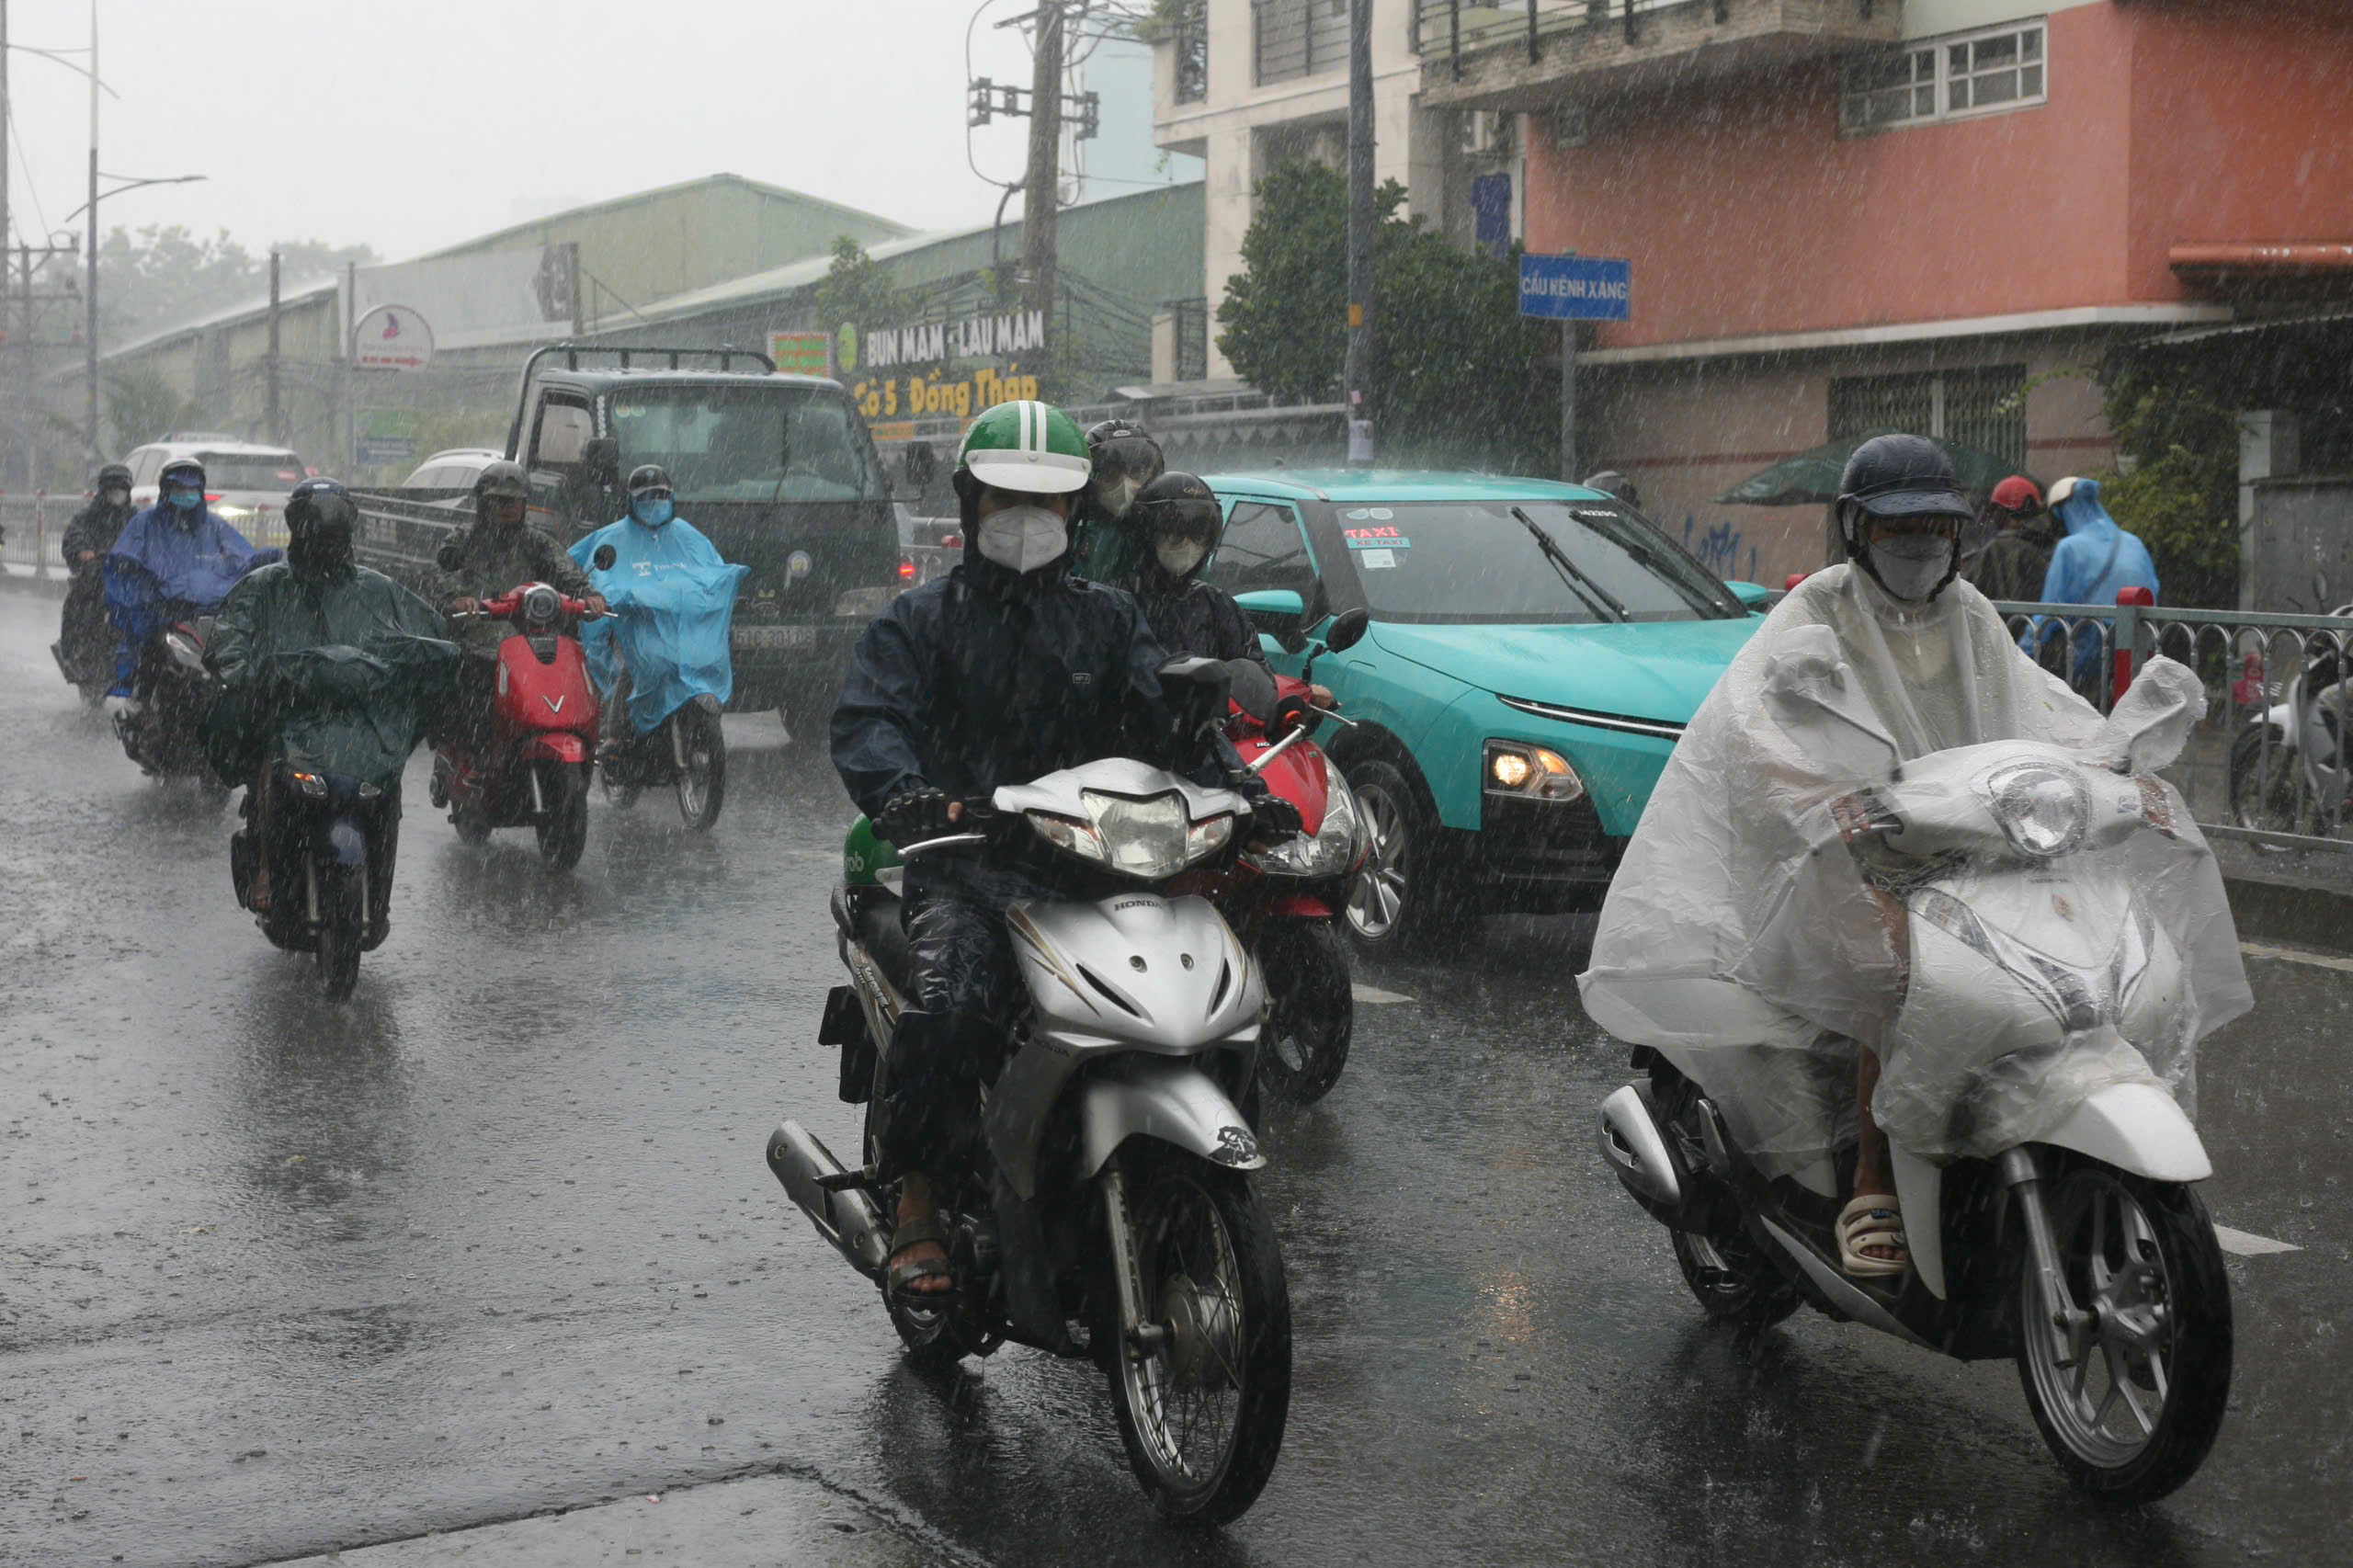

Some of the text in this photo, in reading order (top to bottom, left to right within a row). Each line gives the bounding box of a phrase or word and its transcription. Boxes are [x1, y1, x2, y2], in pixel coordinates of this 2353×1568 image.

[885, 379, 898, 416] 5
[1345, 526, 1401, 540] TAXI
[1114, 900, 1163, 912] HONDA
